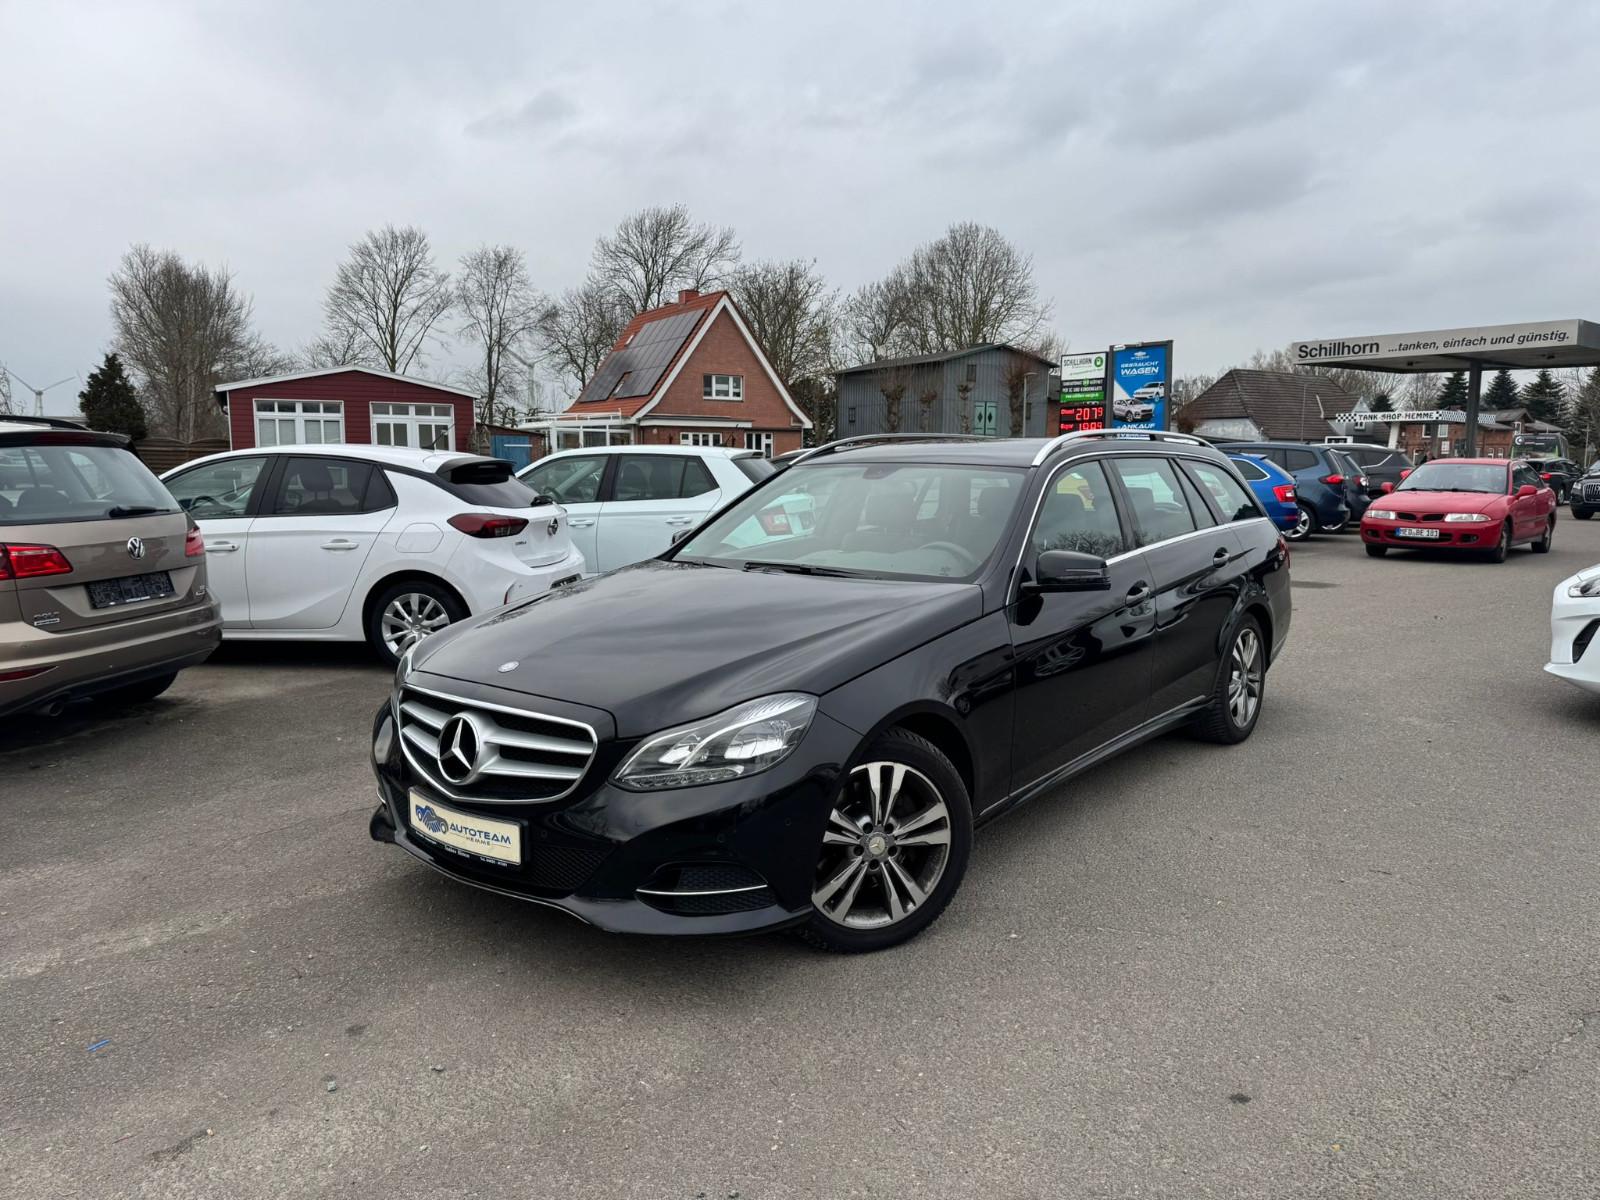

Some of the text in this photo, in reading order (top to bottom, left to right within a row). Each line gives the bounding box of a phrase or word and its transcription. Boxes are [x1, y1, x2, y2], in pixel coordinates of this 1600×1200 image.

[1298, 330, 1570, 359] Schillhorn ...tanken, einfach und günstig.
[1120, 367, 1159, 376] WAGEN
[1404, 411, 1434, 420] HEMME
[449, 822, 512, 845] AUTOTEAM
[465, 836, 491, 846] HEMME
